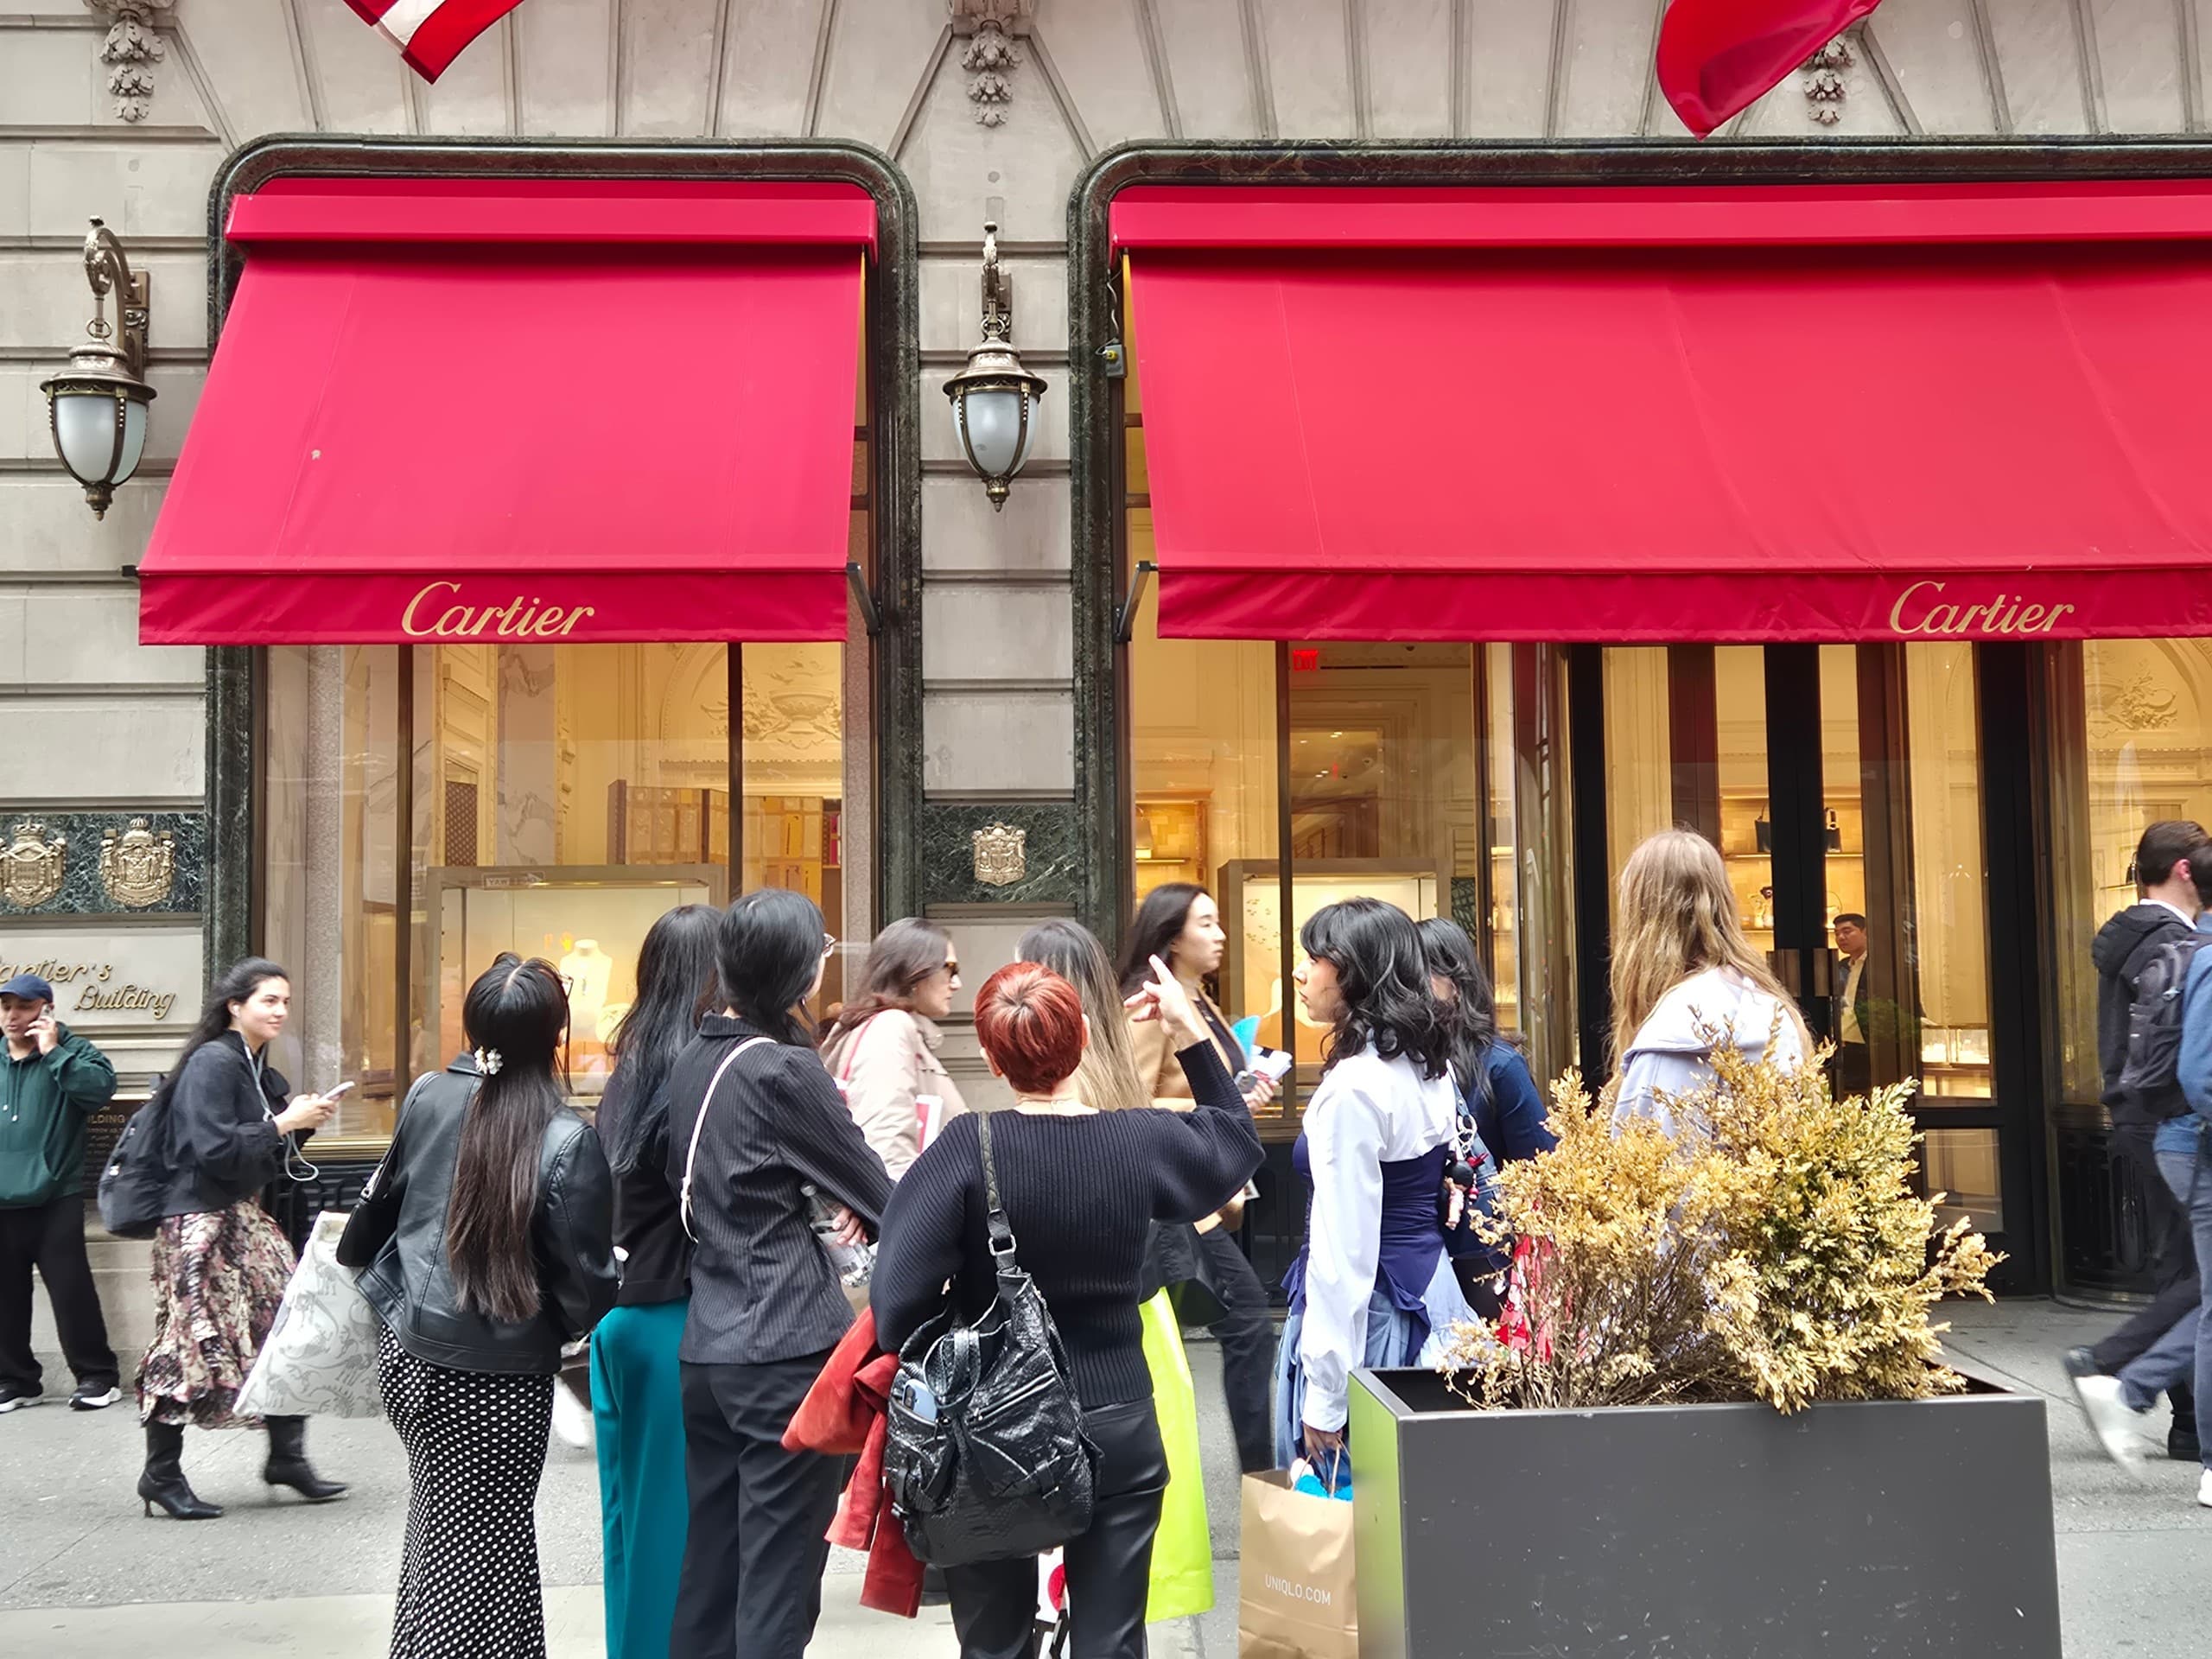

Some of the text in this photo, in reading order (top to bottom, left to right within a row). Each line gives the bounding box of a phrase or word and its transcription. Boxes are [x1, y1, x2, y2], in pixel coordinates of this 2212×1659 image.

[401, 581, 595, 637] Cartier
[1889, 580, 2075, 634] Cartier
[1293, 649, 1319, 671] EXIT
[0, 957, 112, 983] artier's
[74, 984, 175, 1020] Building
[1265, 1573, 1332, 1606] UNIQLO.COM
